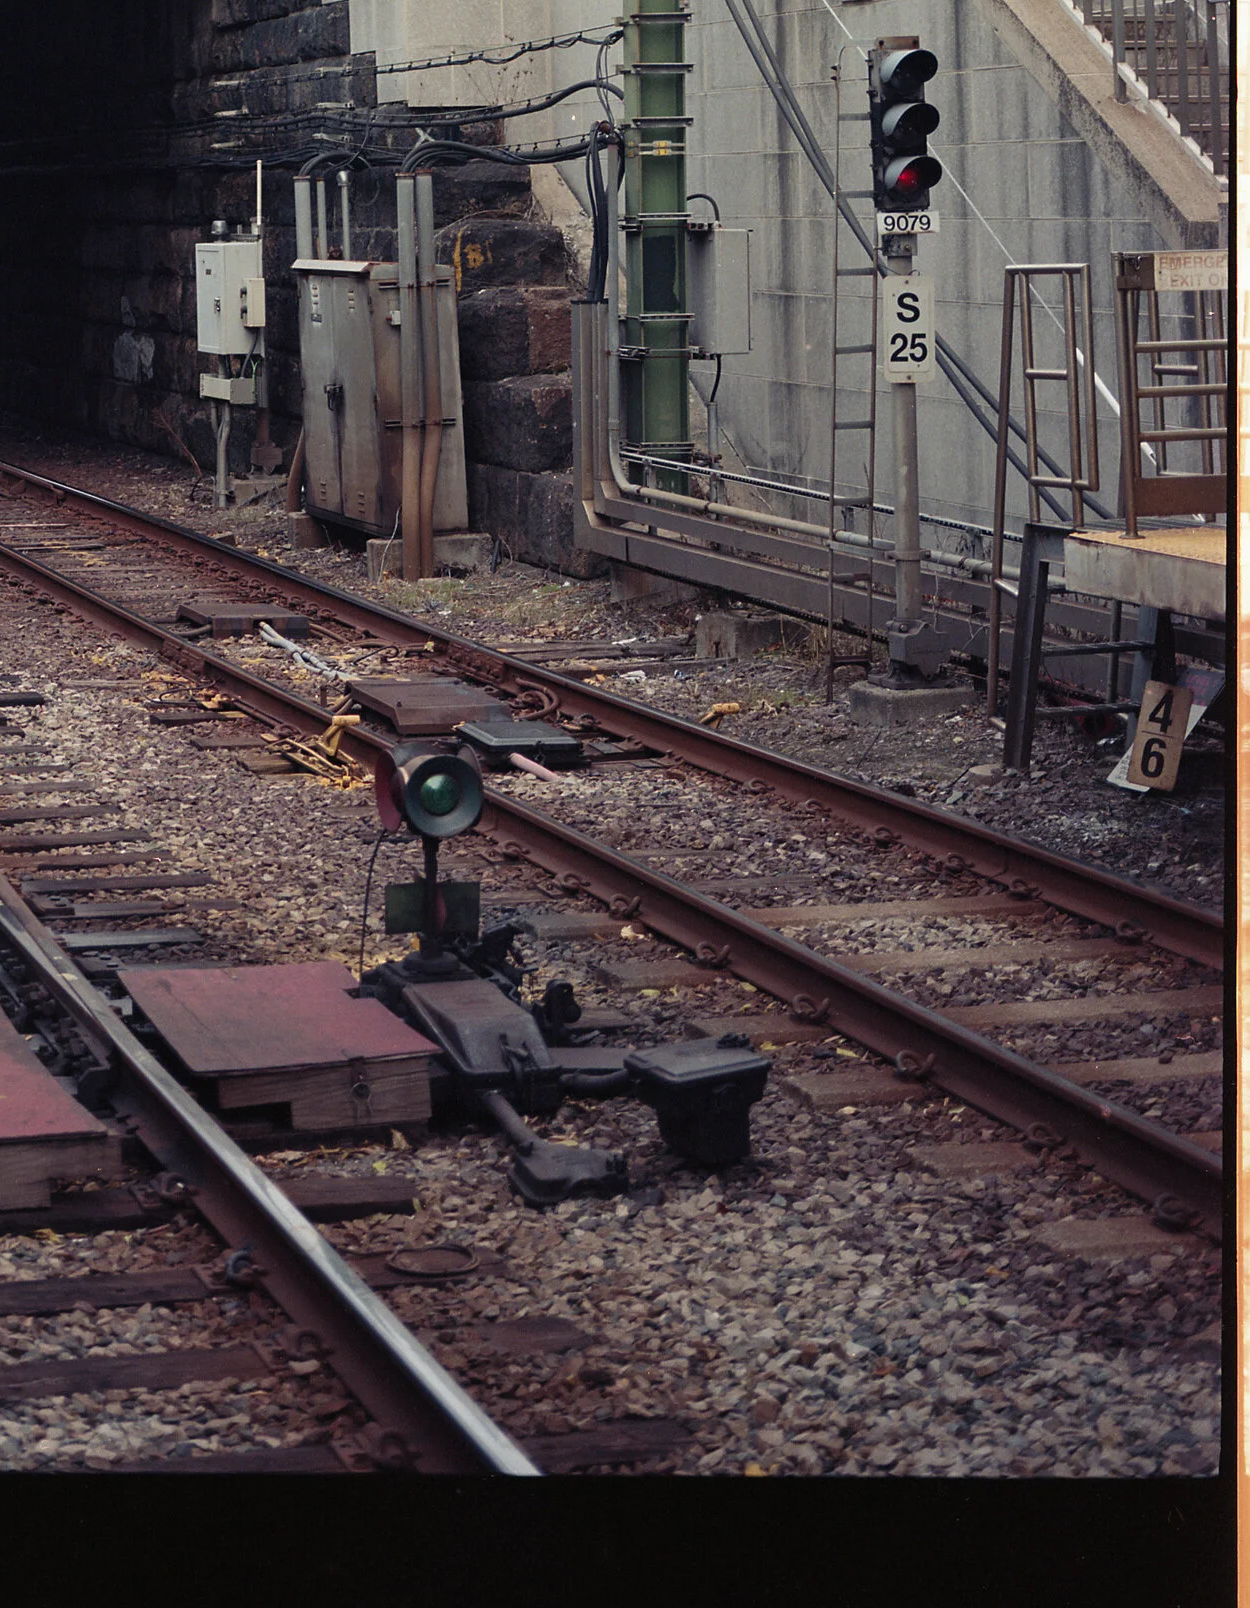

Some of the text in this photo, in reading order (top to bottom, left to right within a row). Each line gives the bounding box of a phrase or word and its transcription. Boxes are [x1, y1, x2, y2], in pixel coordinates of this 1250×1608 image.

[883, 214, 931, 231] 9079
[1170, 273, 1203, 288] EXIT
[896, 292, 920, 323] S
[890, 332, 928, 363] 25
[1148, 689, 1175, 734] 4
[1140, 738, 1167, 778] 6
